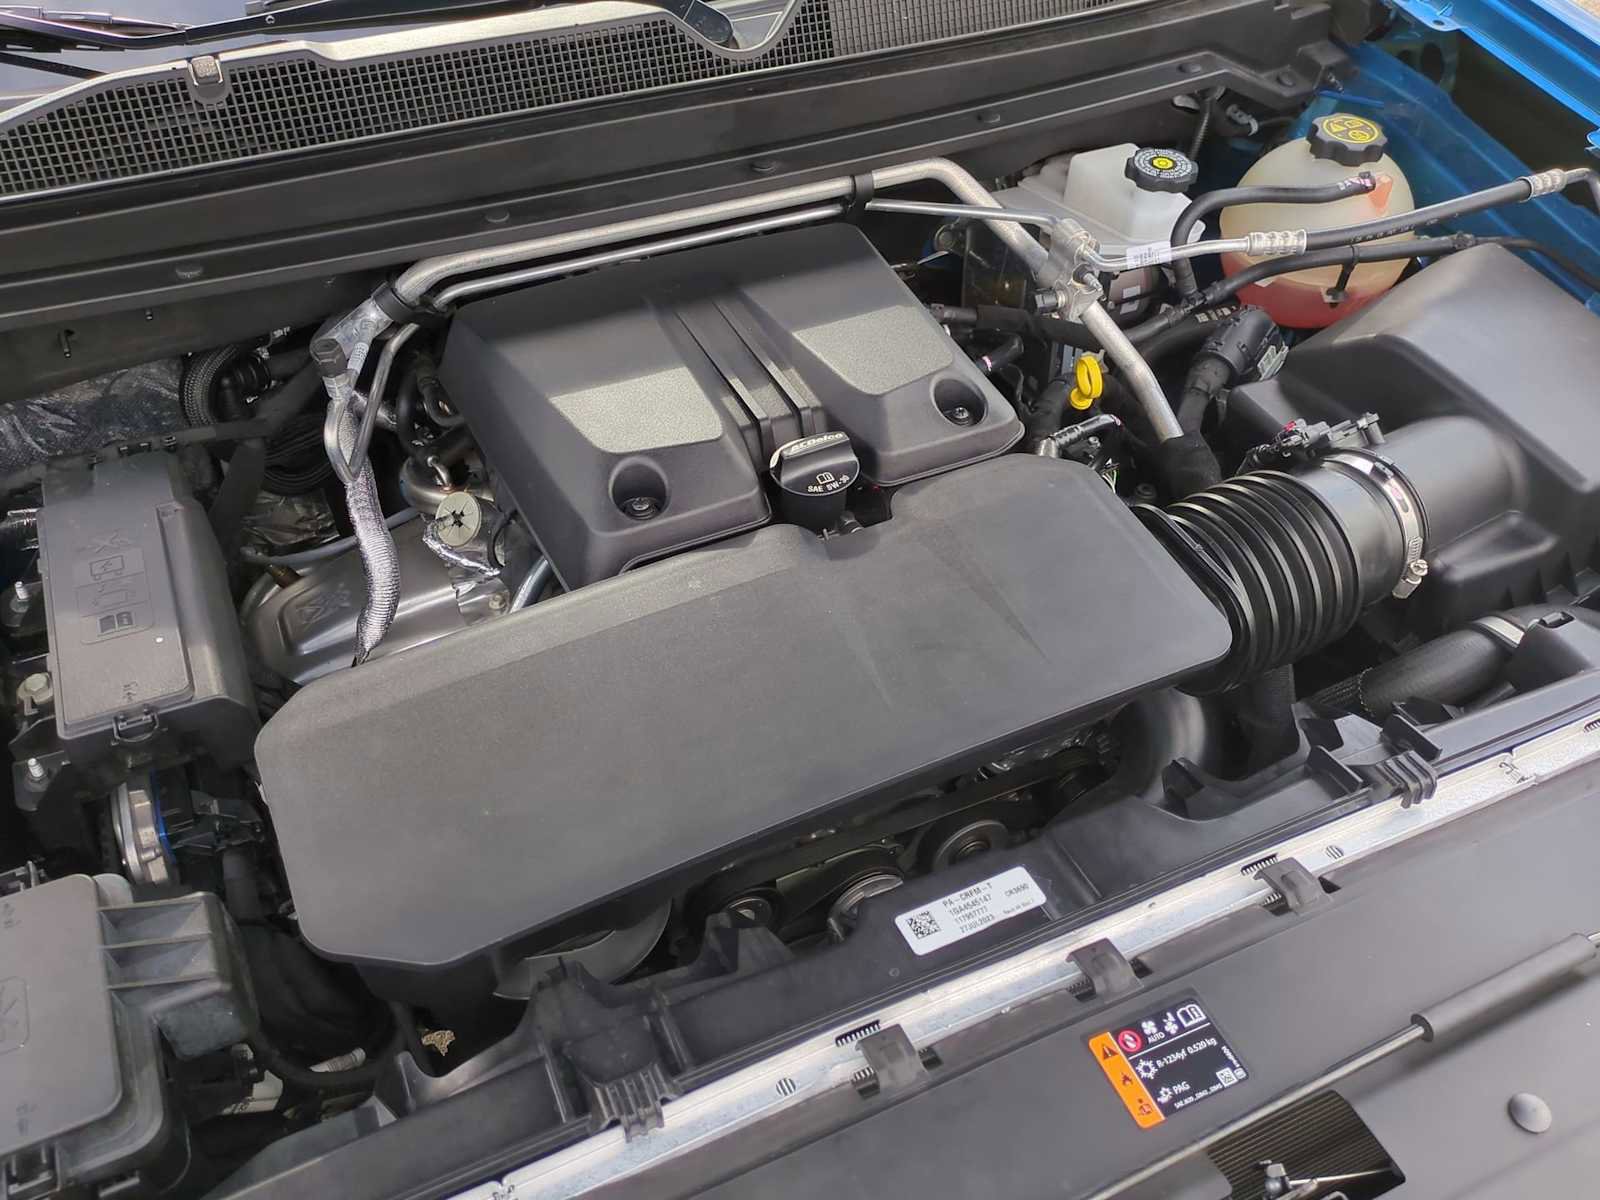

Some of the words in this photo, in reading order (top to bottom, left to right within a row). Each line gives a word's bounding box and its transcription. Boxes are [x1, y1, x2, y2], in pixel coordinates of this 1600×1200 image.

[807, 485, 824, 493] SAE
[1147, 1031, 1166, 1044] AUTO
[1156, 1048, 1188, 1069] R-1234yf
[1187, 1040, 1207, 1054] 0.520
[1206, 1037, 1218, 1047] kg
[1172, 1081, 1191, 1095] PAG
